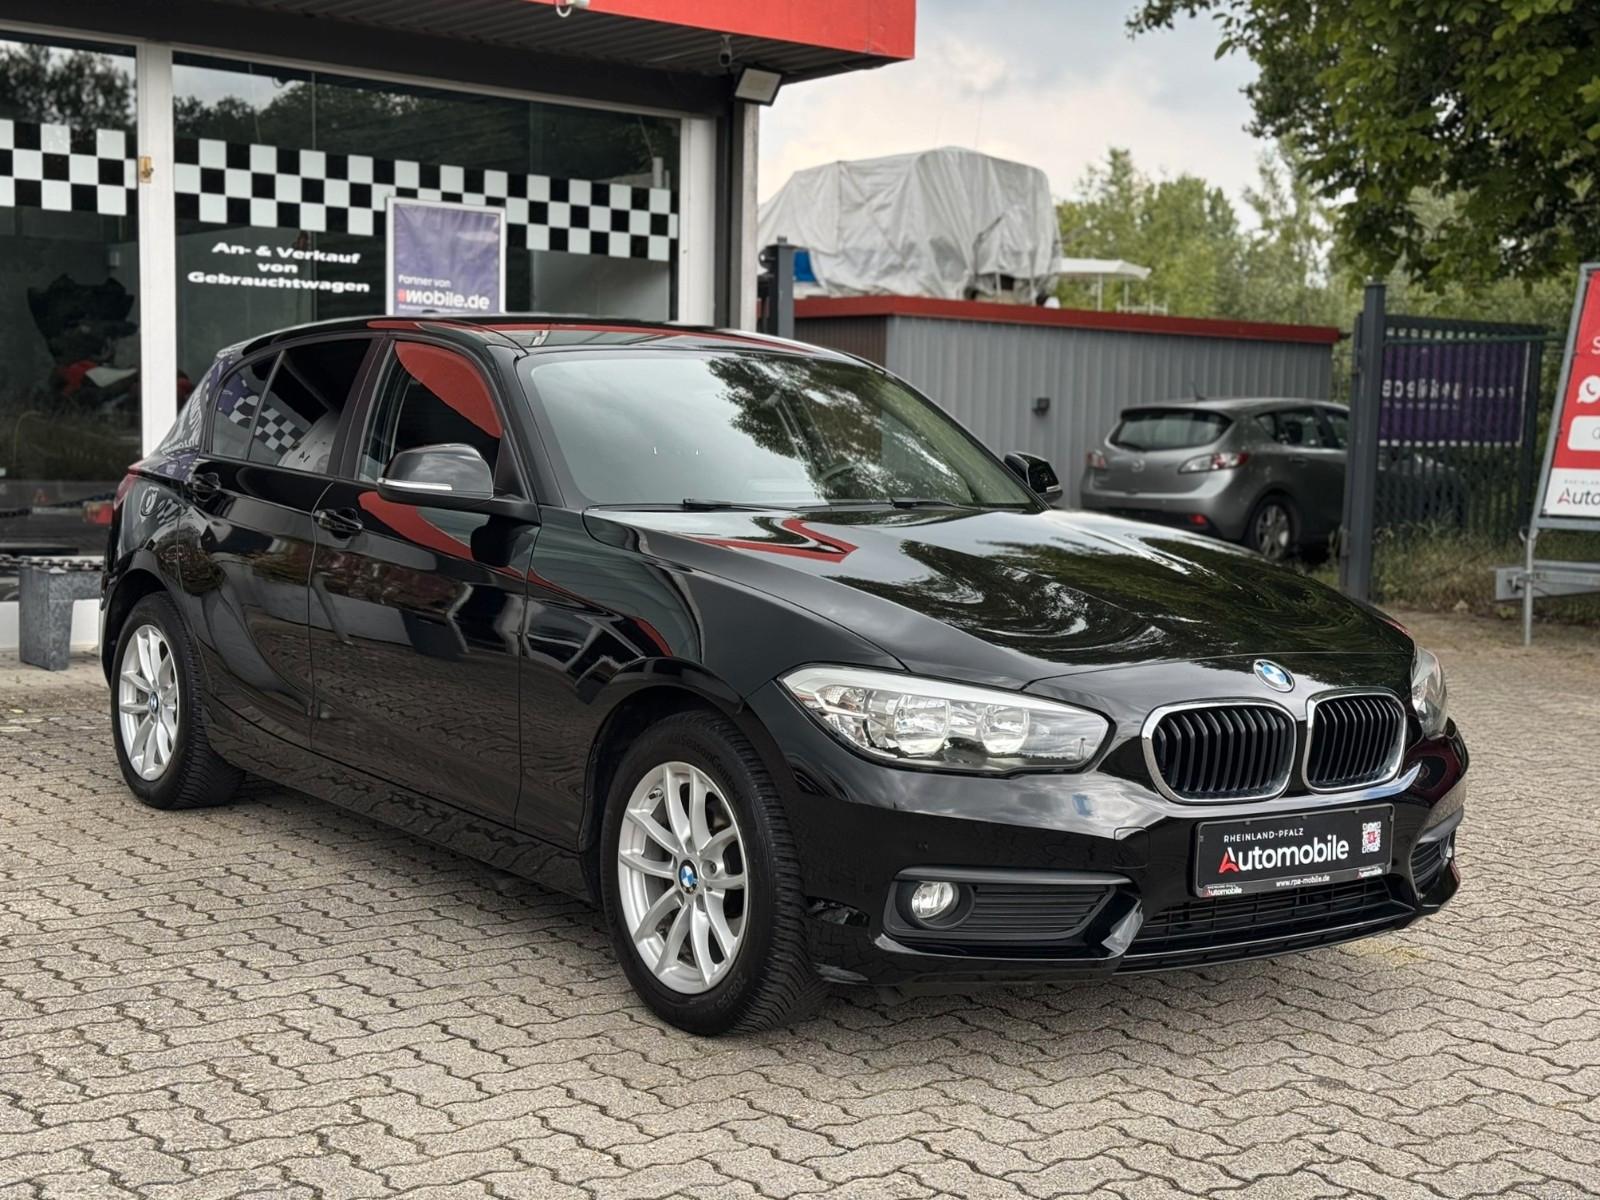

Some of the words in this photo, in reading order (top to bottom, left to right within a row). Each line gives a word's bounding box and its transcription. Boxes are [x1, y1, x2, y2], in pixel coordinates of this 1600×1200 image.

[211, 242, 251, 255] An-
[255, 245, 272, 257] &
[276, 247, 361, 264] Verkauf
[257, 262, 298, 274] von
[187, 271, 370, 293] Gebrauchtwagen
[398, 274, 432, 286] Partner
[433, 278, 452, 288] von
[1223, 827, 1304, 843] RHEINLAND-PFALZ
[1218, 834, 1350, 874] Automobile
